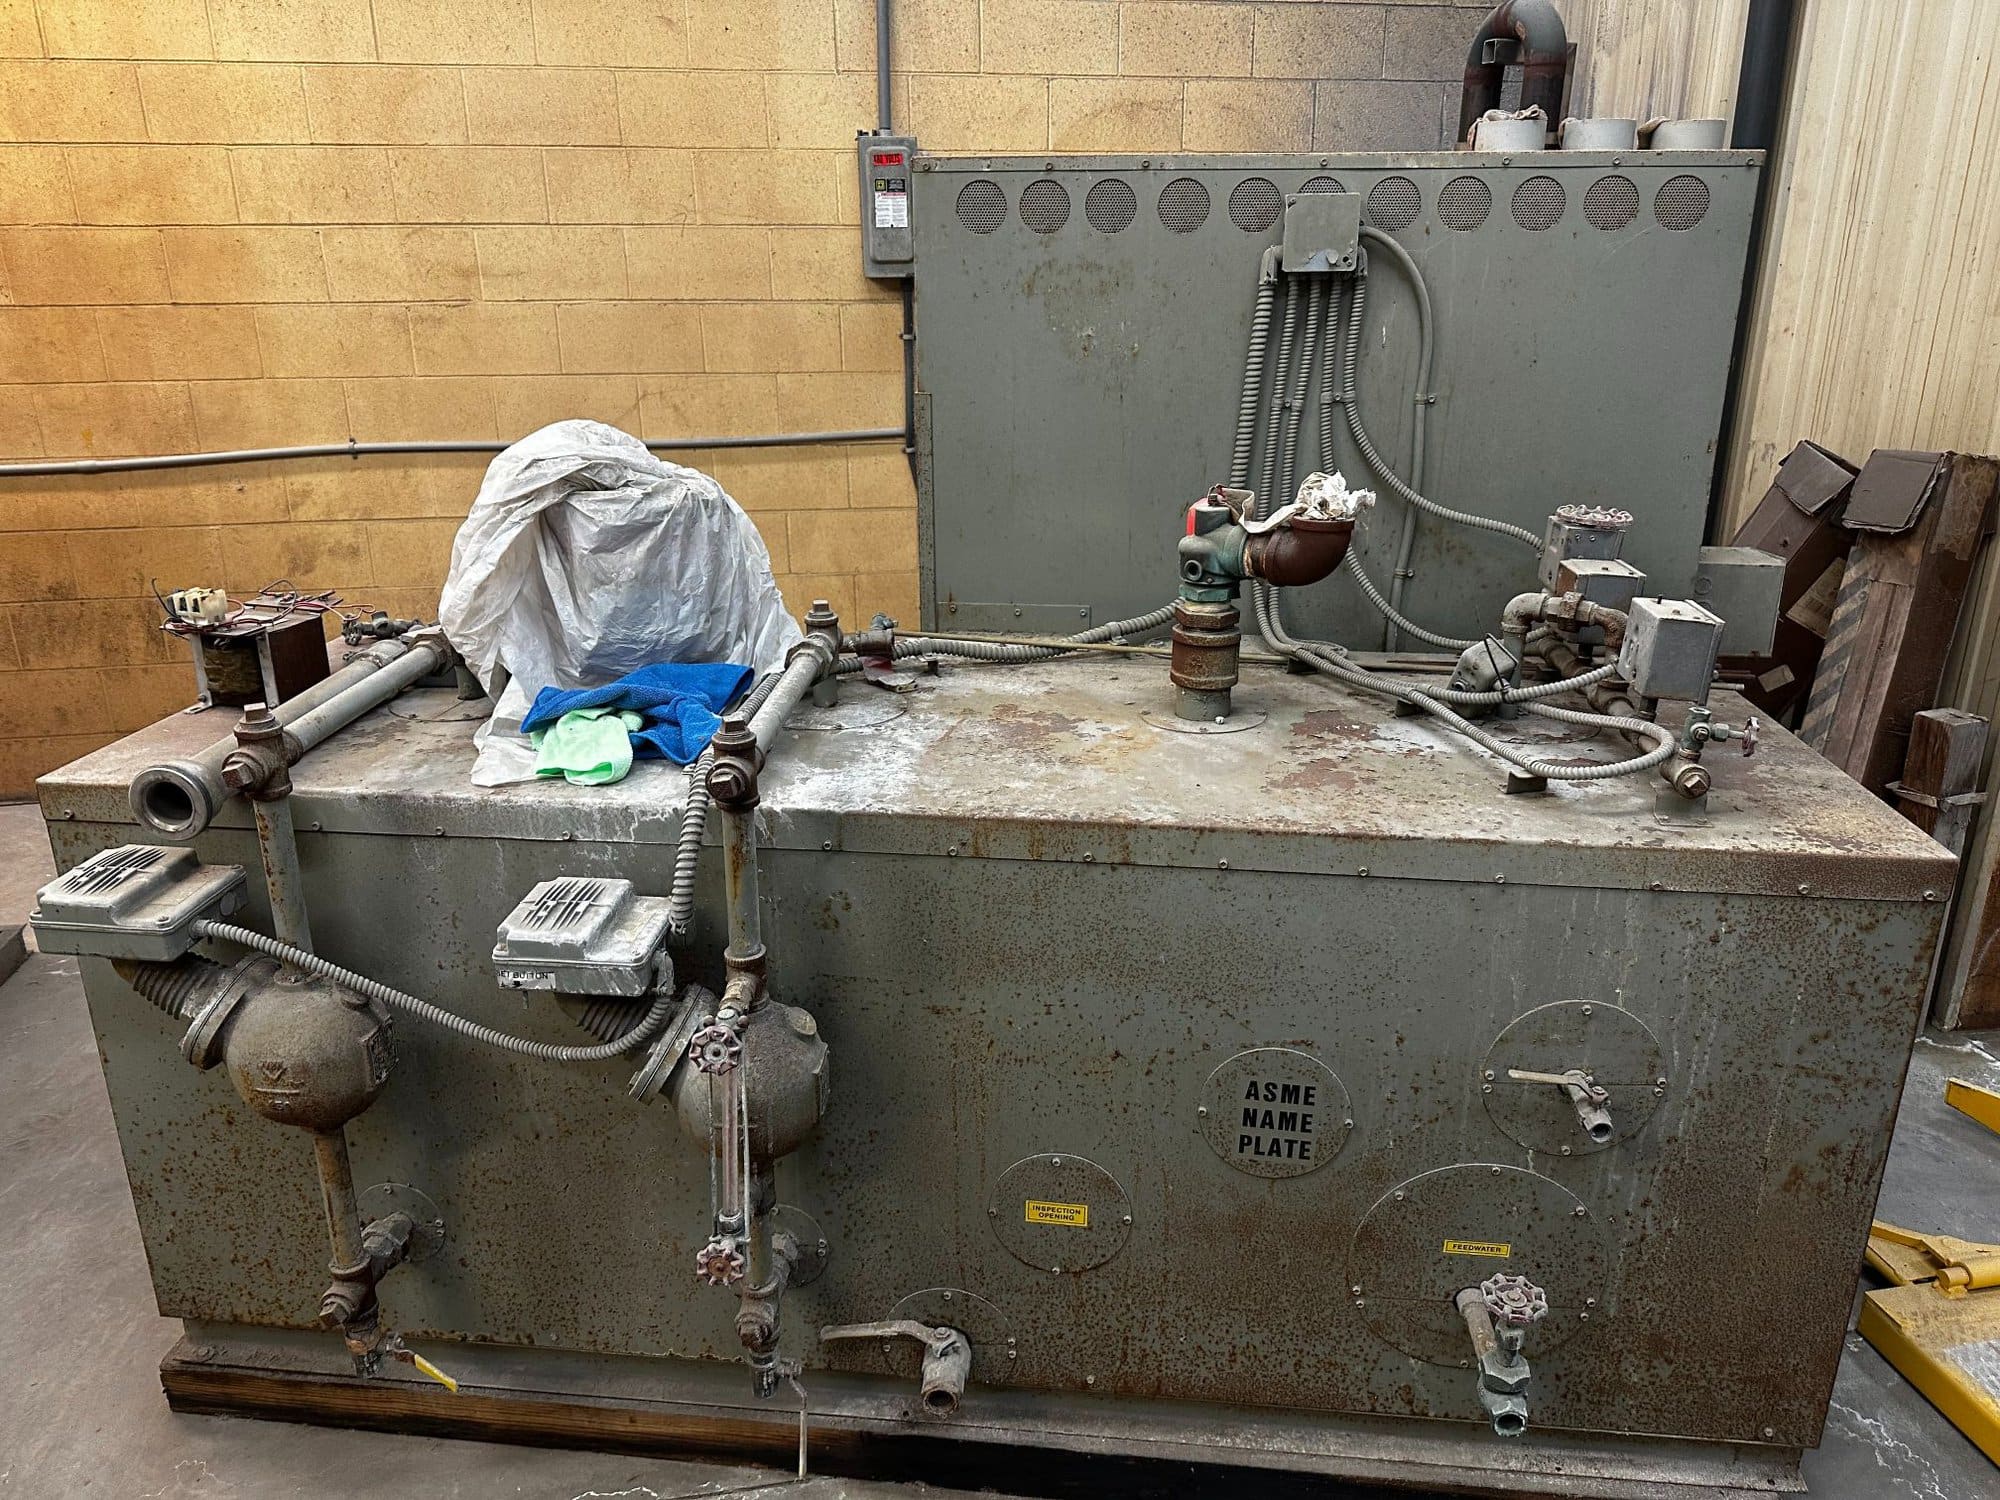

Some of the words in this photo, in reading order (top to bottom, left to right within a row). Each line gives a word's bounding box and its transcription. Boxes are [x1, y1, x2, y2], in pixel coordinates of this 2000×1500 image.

[1245, 1081, 1316, 1106] ASME
[1242, 1107, 1313, 1133] NAME
[1238, 1134, 1311, 1160] PLATE
[1032, 1205, 1081, 1215] INSPECTION
[1038, 1212, 1075, 1221] OPENING
[1452, 1243, 1503, 1253] FEEDWATER
